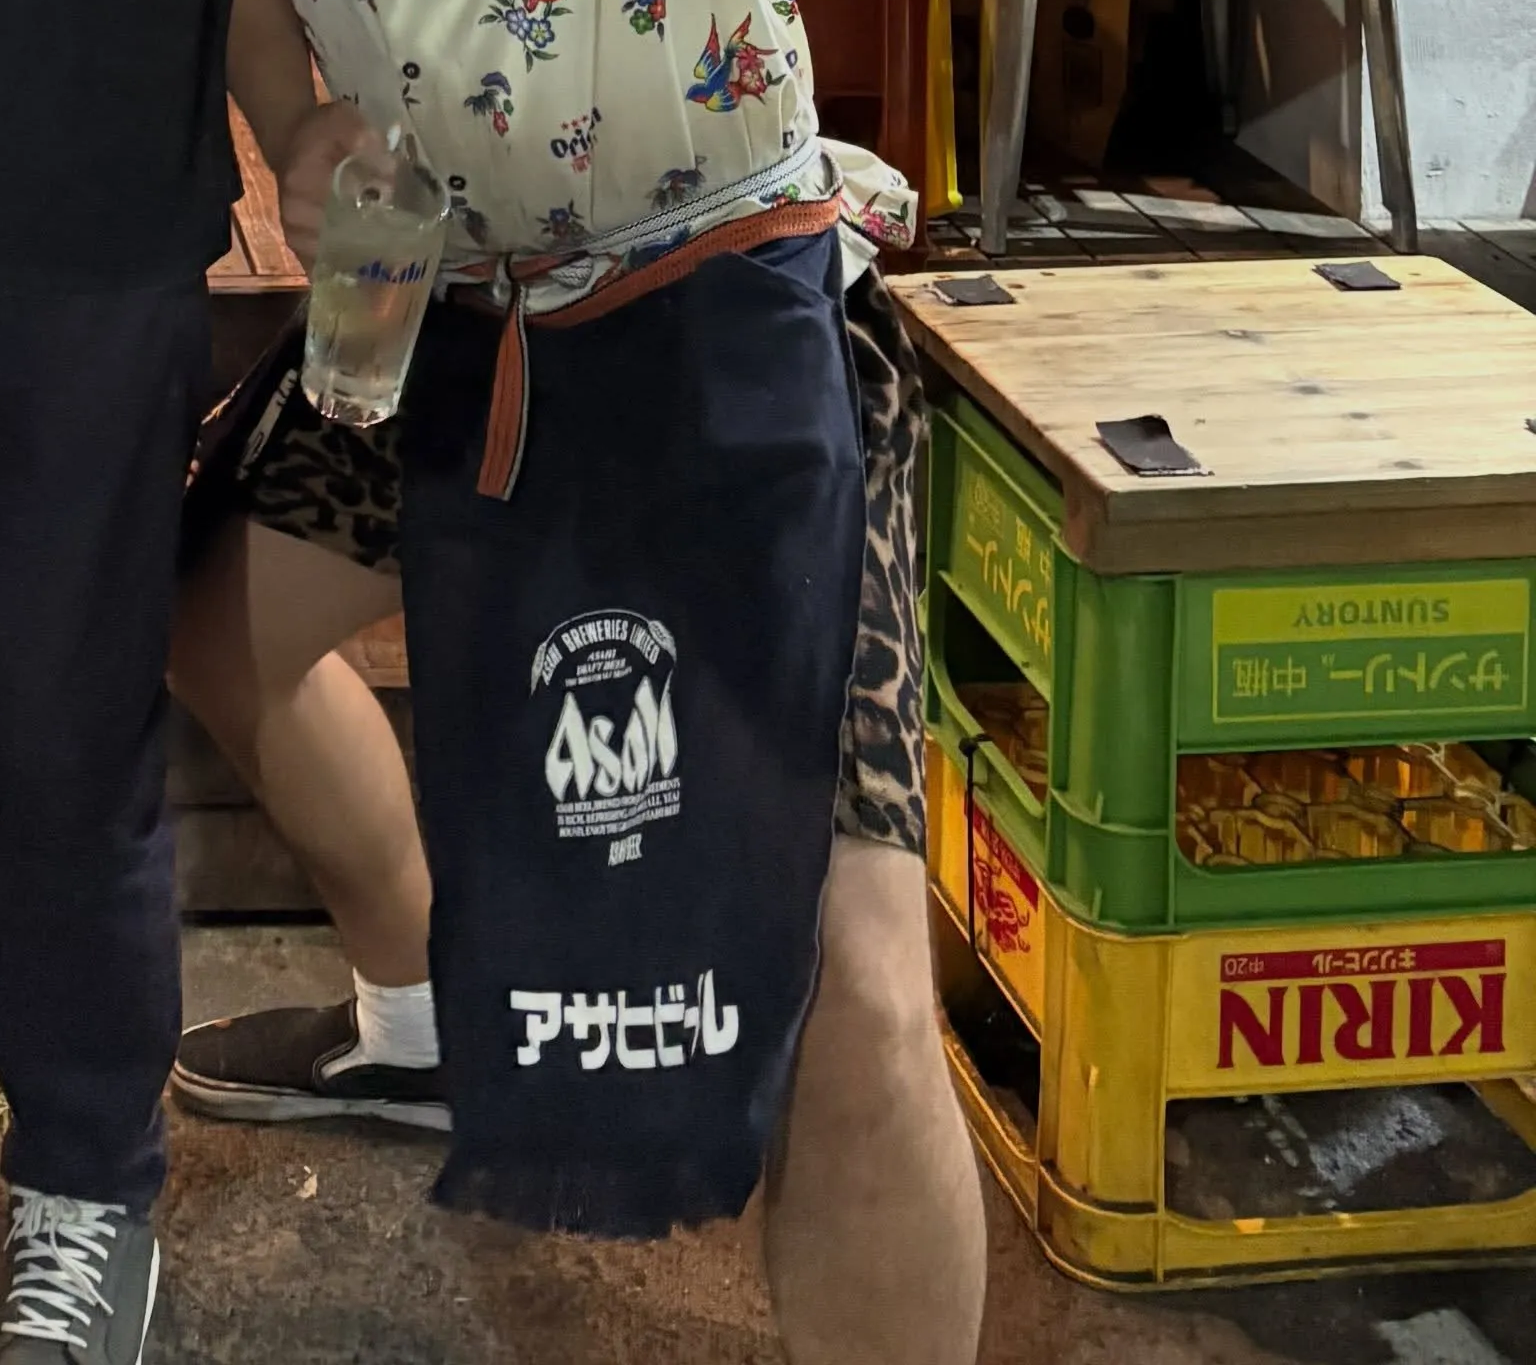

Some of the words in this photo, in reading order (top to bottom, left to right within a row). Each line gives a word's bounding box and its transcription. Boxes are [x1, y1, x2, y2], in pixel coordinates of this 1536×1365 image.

[1293, 597, 1450, 627] SUNTORY
[561, 619, 628, 653] BREWERIES
[1330, 650, 1509, 693] サントリー
[1312, 948, 1417, 974] キリンビール
[1216, 972, 1507, 1069] KIRIN
